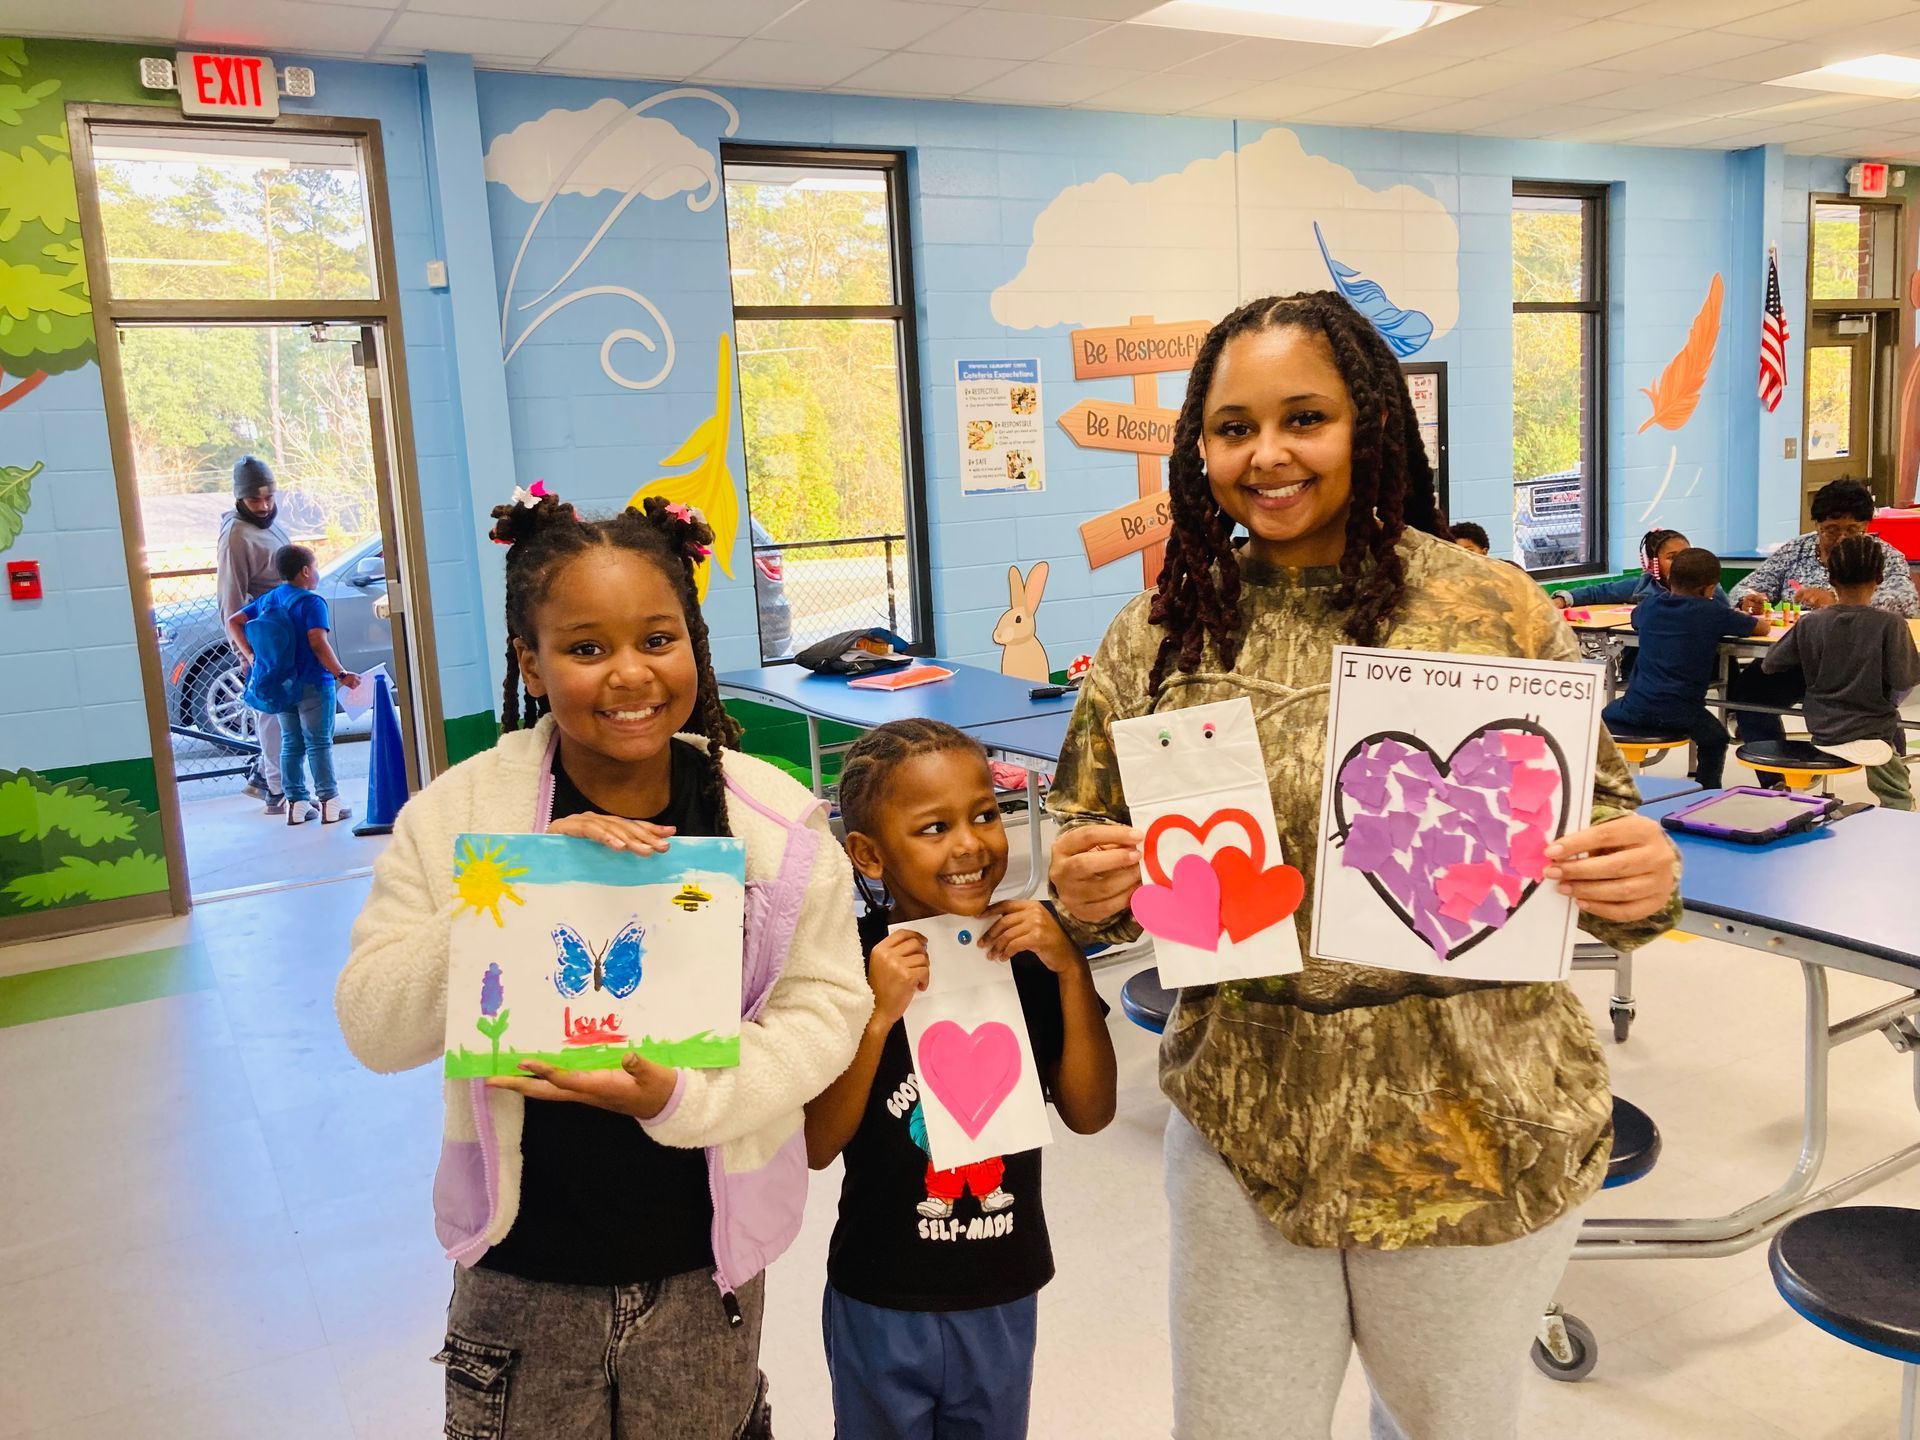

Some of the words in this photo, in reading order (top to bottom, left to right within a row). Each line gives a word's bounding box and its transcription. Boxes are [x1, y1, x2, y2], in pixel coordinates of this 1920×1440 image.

[192, 55, 262, 107] EXIT
[1083, 339, 1108, 366] Be
[1086, 410, 1110, 437] Be
[1116, 414, 1176, 444] Respon
[1120, 515, 1146, 541] Be
[1344, 660, 1358, 678] I
[1367, 662, 1412, 683] love
[1472, 672, 1499, 691] to
[917, 1211, 1014, 1242] SELF-MADE
